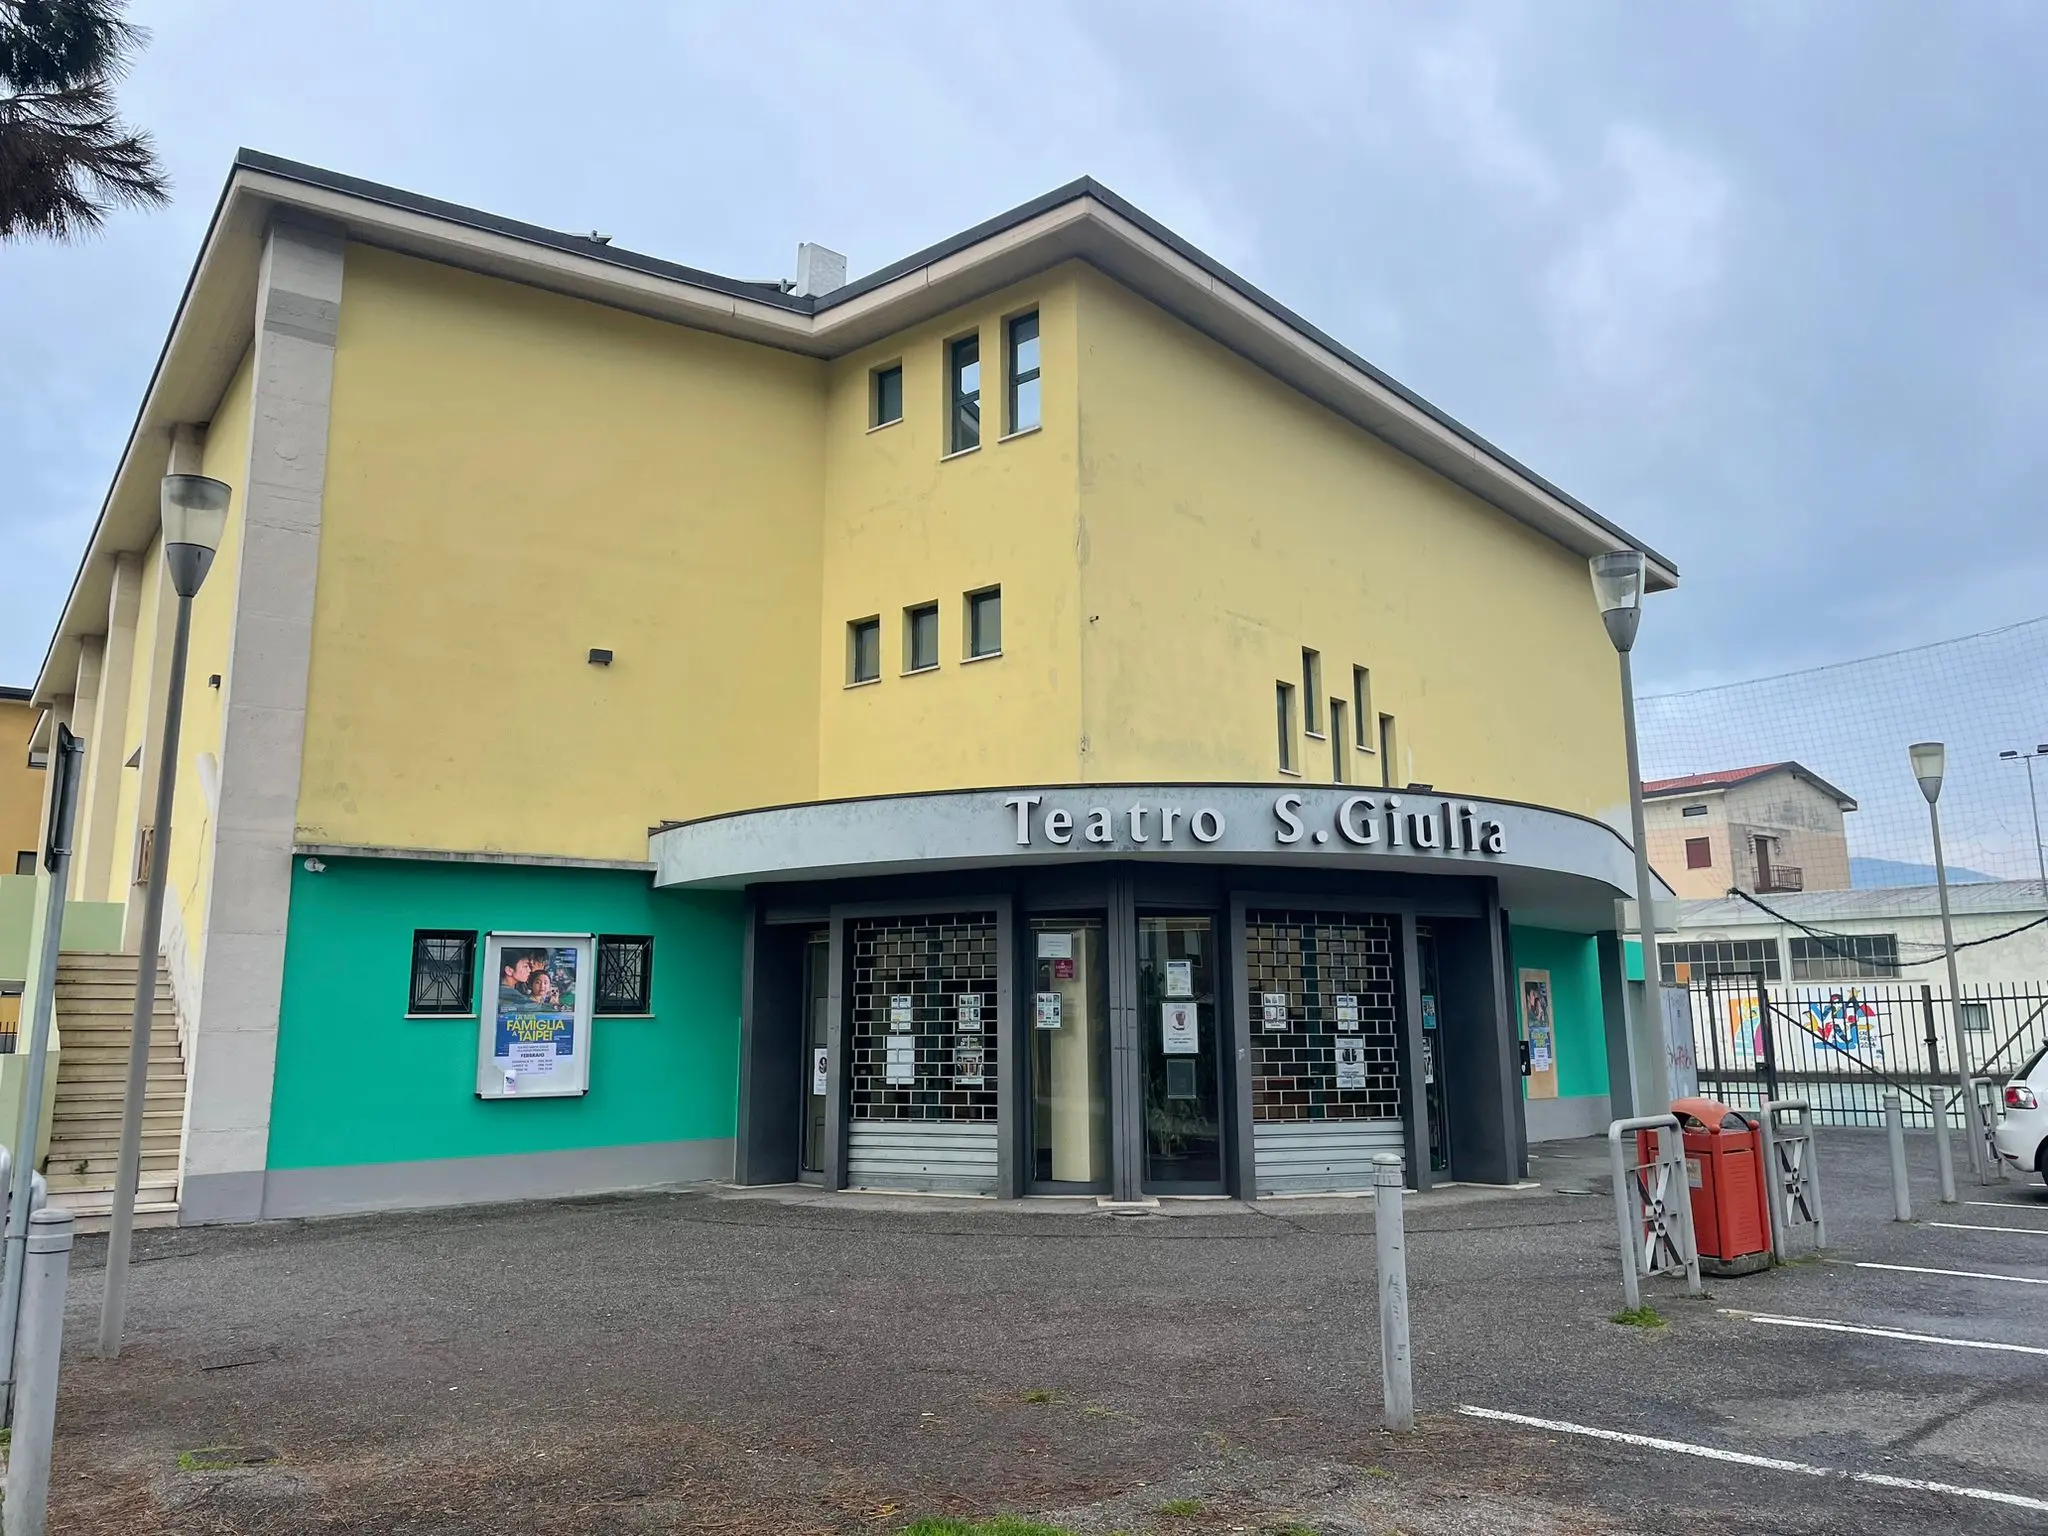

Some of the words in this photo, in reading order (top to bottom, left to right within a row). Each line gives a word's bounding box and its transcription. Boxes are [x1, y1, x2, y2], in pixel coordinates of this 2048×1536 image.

[1005, 797, 1226, 846] Teatro
[506, 1020, 564, 1031] FAMIGLIA
[518, 1030, 552, 1041] TAIPEI
